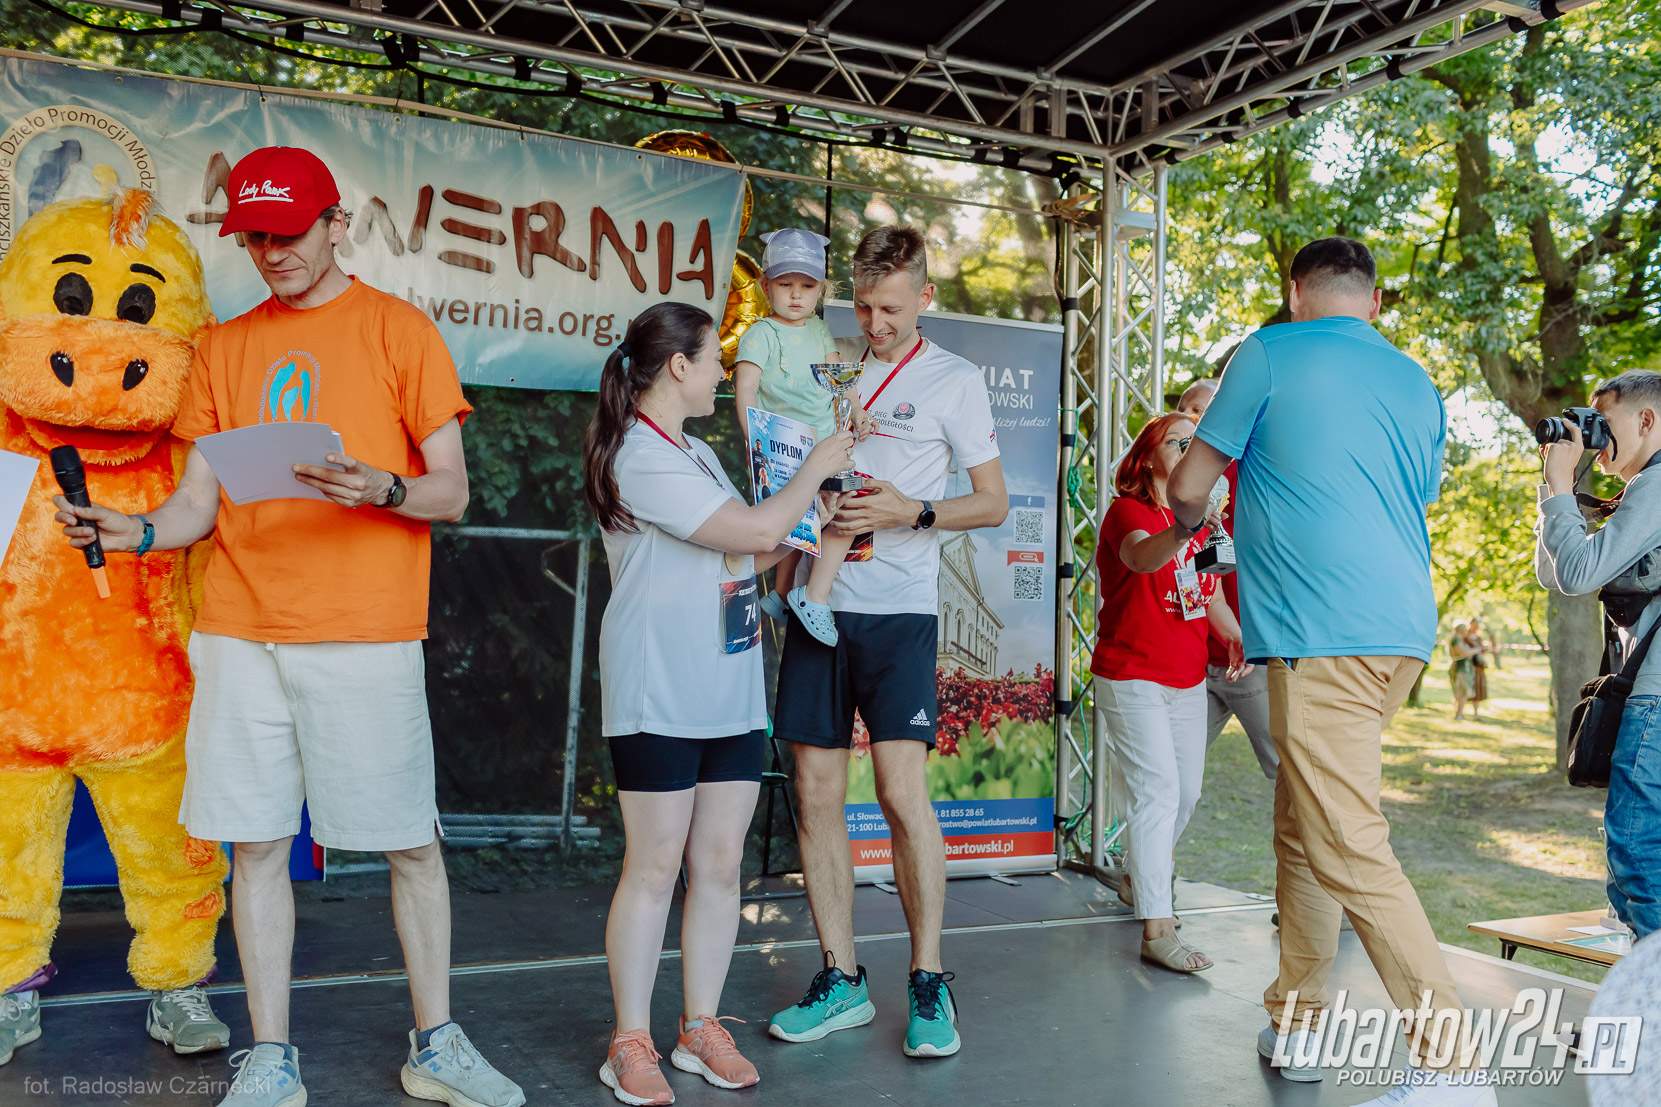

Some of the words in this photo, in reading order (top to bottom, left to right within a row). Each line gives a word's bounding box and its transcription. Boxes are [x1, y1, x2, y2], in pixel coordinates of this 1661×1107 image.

[47, 107, 129, 142] Promocji
[124, 140, 157, 190] Młodz
[186, 152, 715, 301] AWERNIA
[982, 365, 1034, 391] IAT
[769, 439, 804, 462] DYPLOM
[910, 719, 931, 727] adidas
[857, 812, 886, 821] Słowac
[940, 809, 950, 818] 81
[951, 808, 965, 817] 855
[965, 808, 975, 817] 28
[975, 808, 985, 816] 65
[847, 823, 873, 832] 21-100
